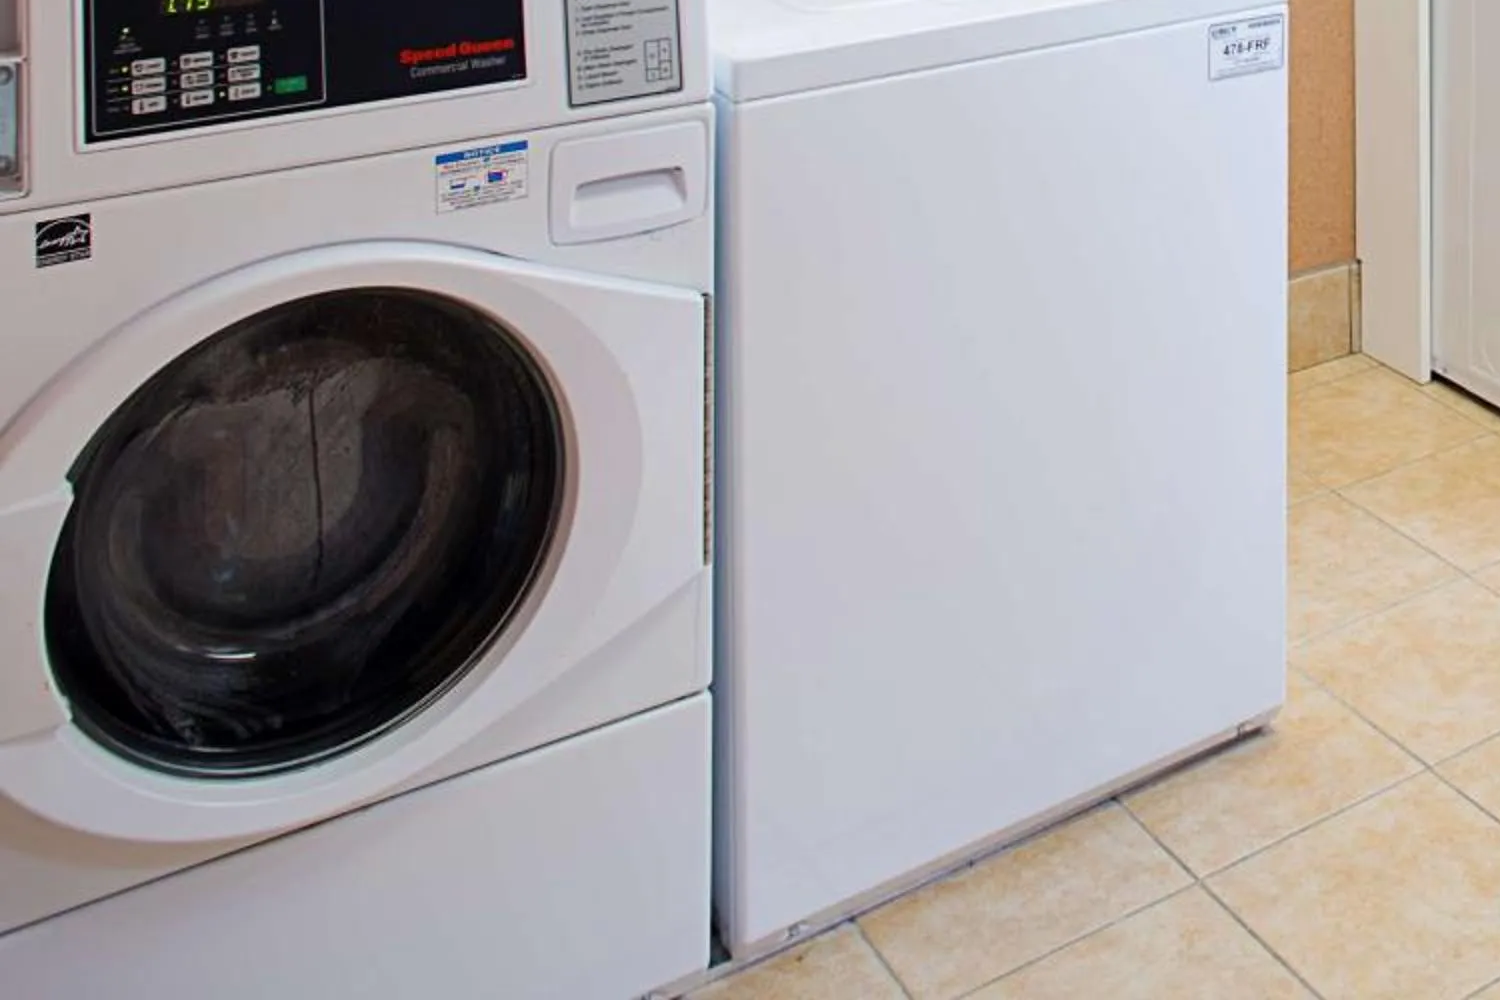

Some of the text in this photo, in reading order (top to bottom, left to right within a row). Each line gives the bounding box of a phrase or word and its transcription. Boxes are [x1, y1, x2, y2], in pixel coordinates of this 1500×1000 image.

[400, 38, 514, 65] Speed Queen
[410, 55, 507, 79] Commercial Washer
